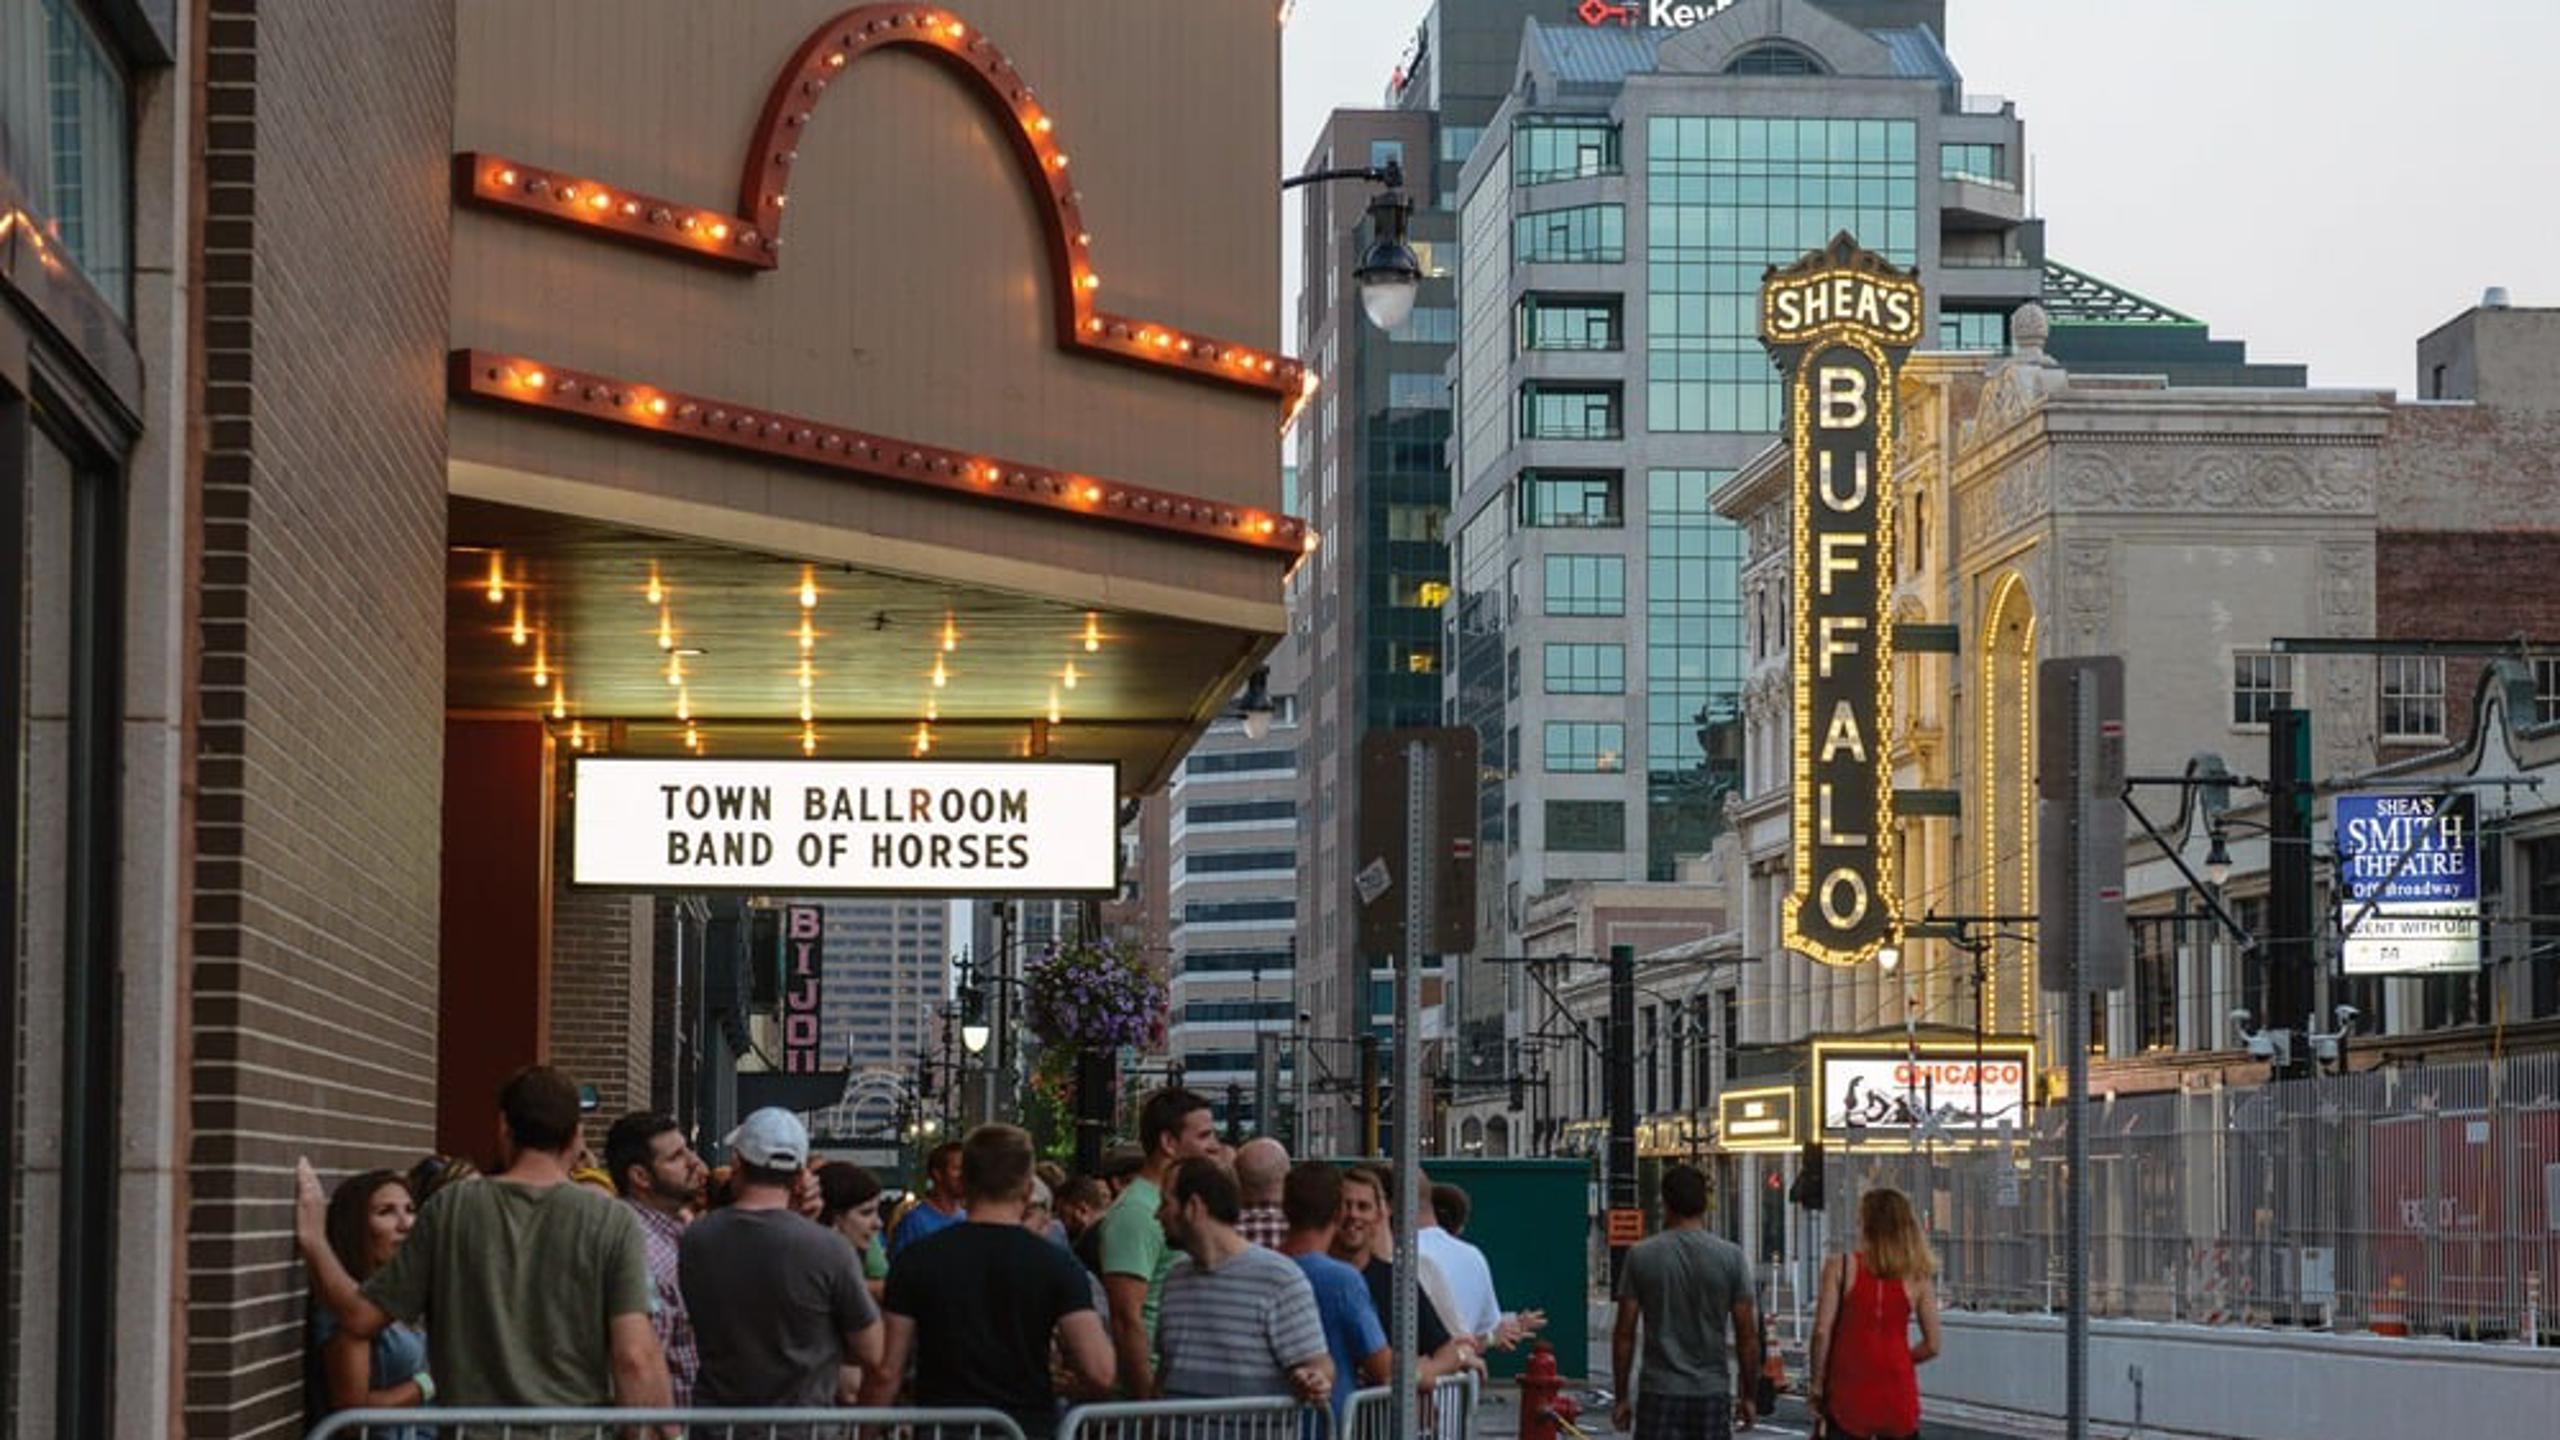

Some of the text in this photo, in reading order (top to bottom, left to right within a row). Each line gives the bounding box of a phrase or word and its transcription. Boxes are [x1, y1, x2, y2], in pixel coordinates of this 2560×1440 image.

[1777, 279, 1911, 331] SHEA'S
[1818, 367, 1868, 929] BUFFALO
[661, 785, 1028, 823] TOWN BALLROOM
[2376, 797, 2435, 816] SHEA'S
[667, 831, 1029, 869] BAND OF HORSES
[2349, 817, 2463, 854] SMITH
[2354, 853, 2465, 877] THEATRE
[2401, 921, 2439, 934] WITH
